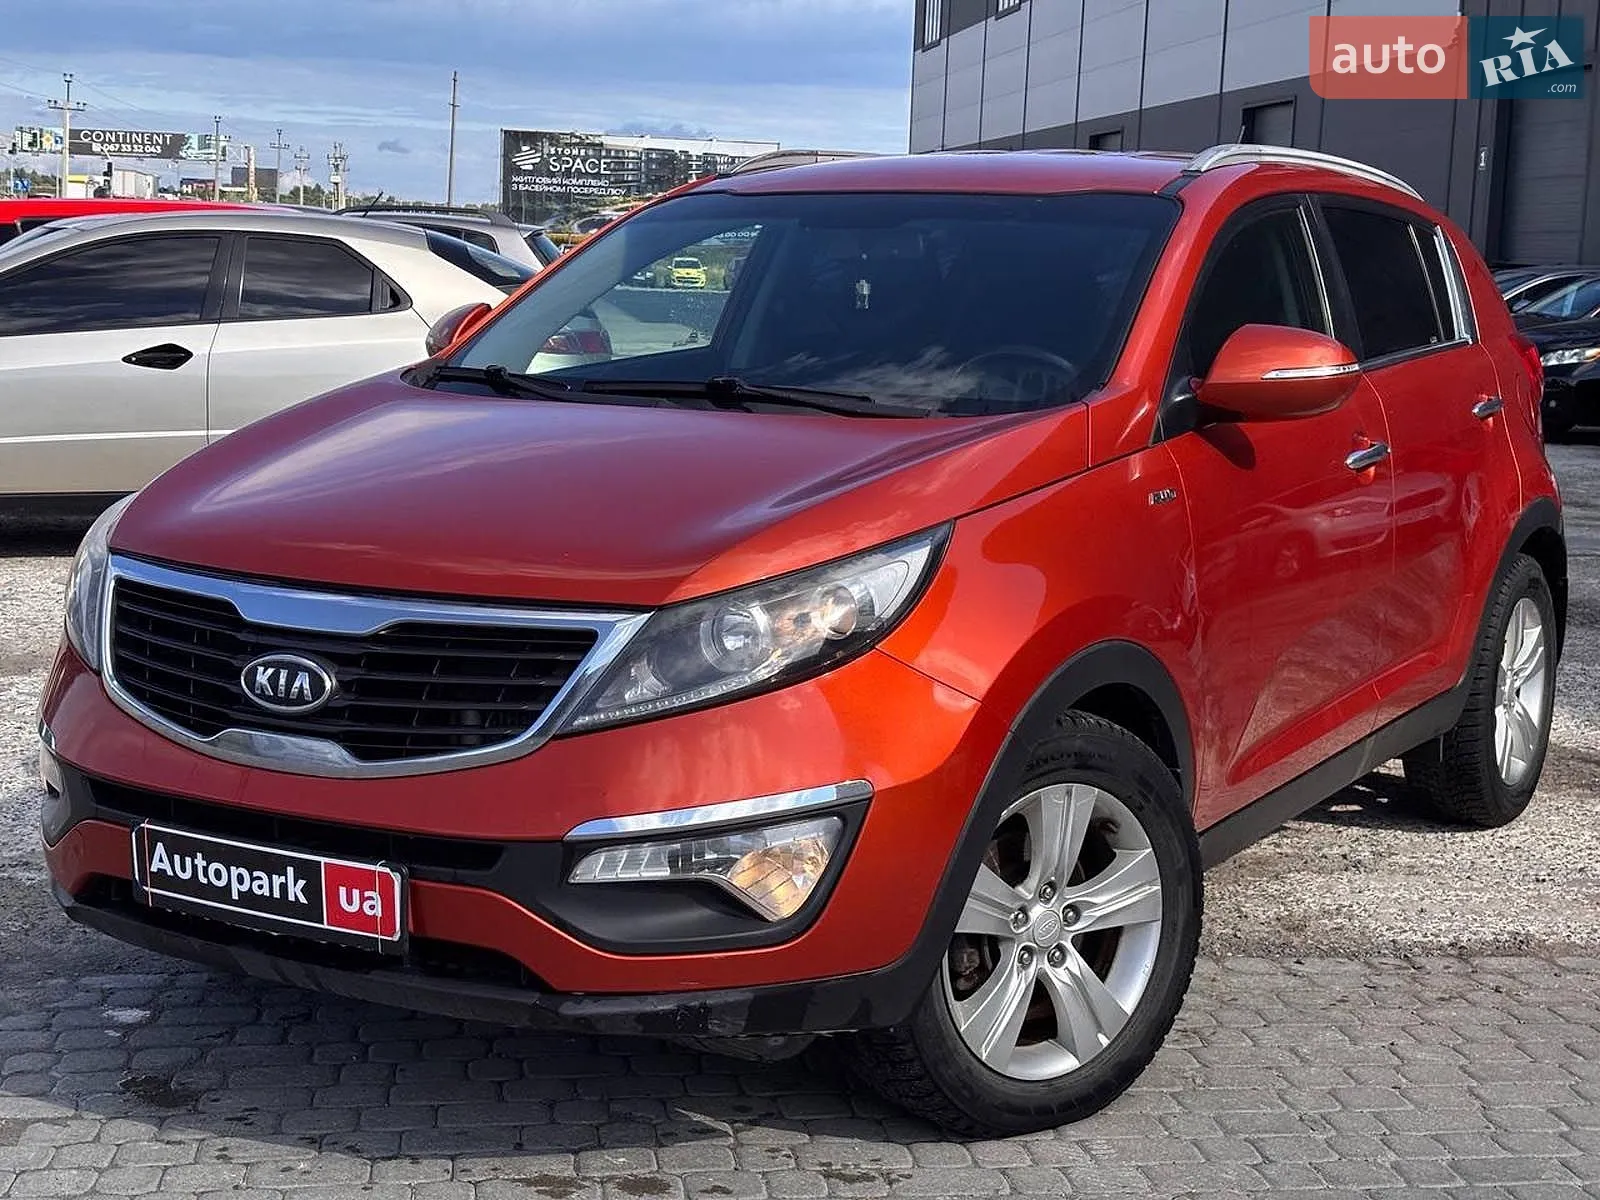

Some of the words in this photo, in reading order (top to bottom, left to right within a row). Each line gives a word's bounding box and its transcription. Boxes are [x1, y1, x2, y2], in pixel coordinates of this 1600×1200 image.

[80, 130, 173, 145] CONTINENT
[549, 157, 612, 174] SPACE
[254, 665, 313, 701] KIA
[150, 842, 309, 904] Autopark
[338, 884, 382, 917] ua
